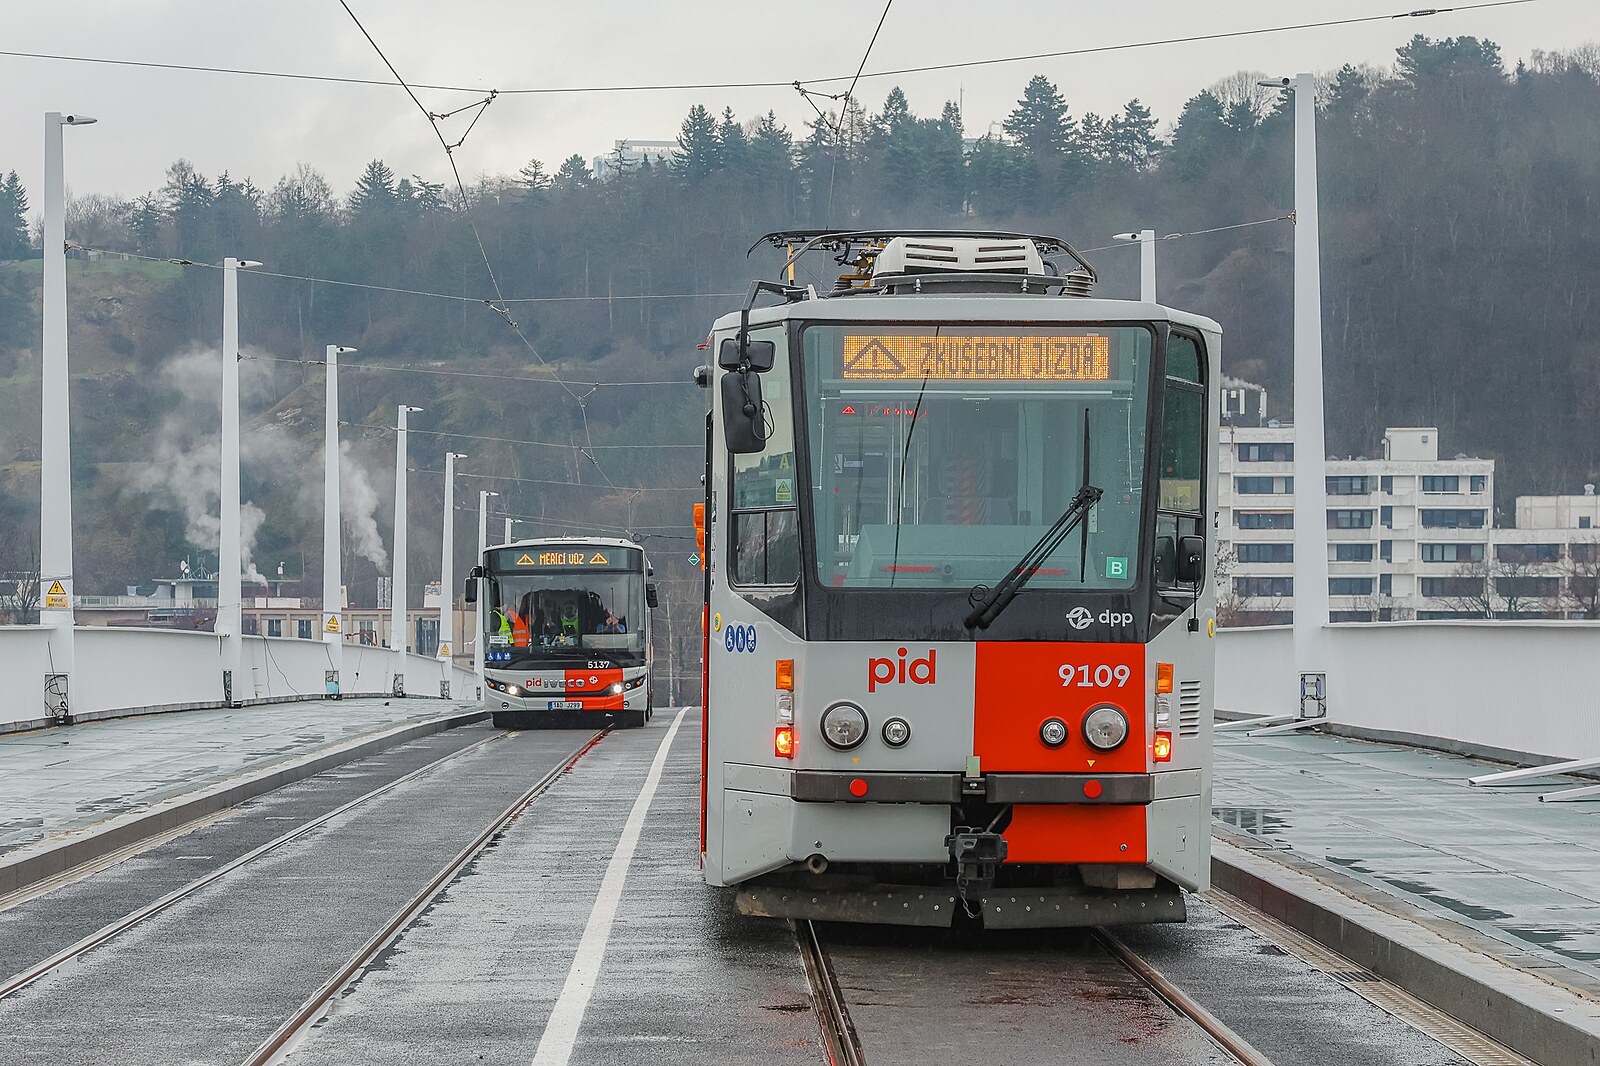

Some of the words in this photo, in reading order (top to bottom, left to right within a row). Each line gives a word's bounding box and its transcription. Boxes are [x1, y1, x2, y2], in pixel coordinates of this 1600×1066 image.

[920, 337, 1021, 375] ZKUŠEBNÍ
[1032, 337, 1094, 375] JÍZDA
[1111, 562, 1123, 575] B
[1098, 609, 1133, 627] dpp
[587, 660, 610, 669] 5137
[868, 647, 936, 693] pid
[526, 678, 542, 688] pid
[1058, 664, 1131, 688] 9109
[544, 679, 586, 689] IVECO
